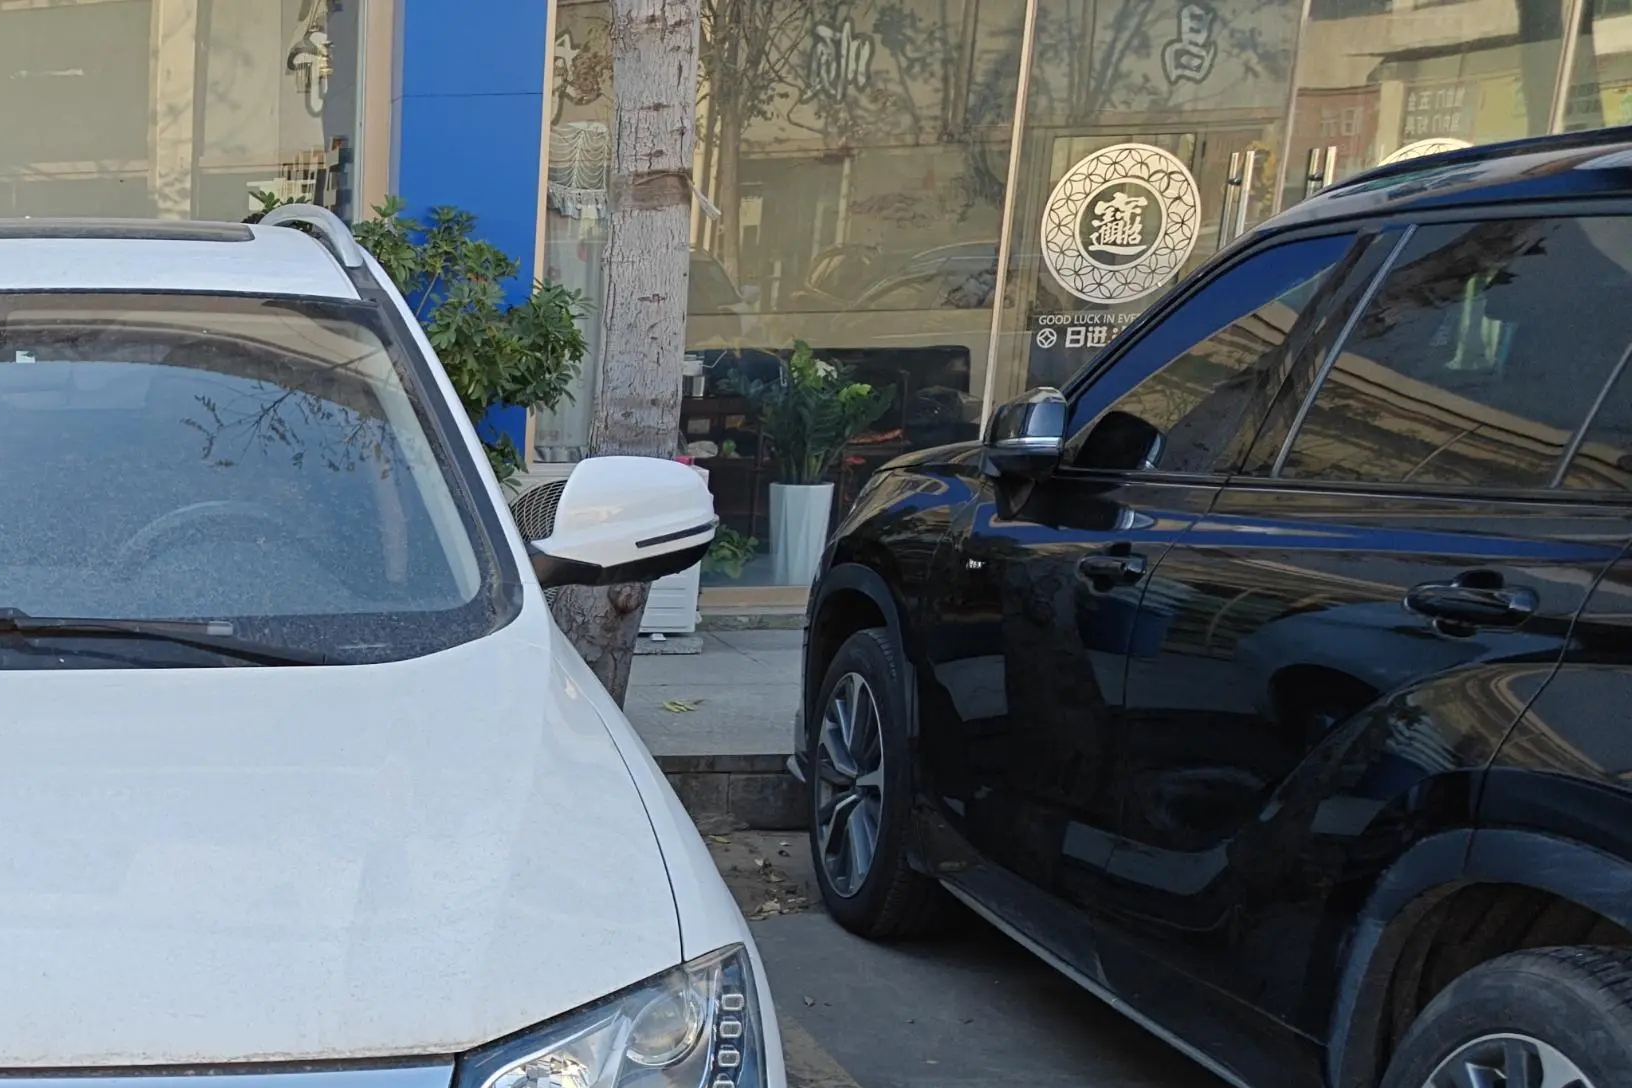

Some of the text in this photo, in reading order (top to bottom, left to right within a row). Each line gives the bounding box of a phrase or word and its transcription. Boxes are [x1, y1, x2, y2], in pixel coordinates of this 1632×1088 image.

[1039, 315, 1071, 325] GOOD
[1074, 314, 1102, 324] LUCK
[1103, 314, 1115, 323] IN
[1065, 326, 1127, 348] 日进
